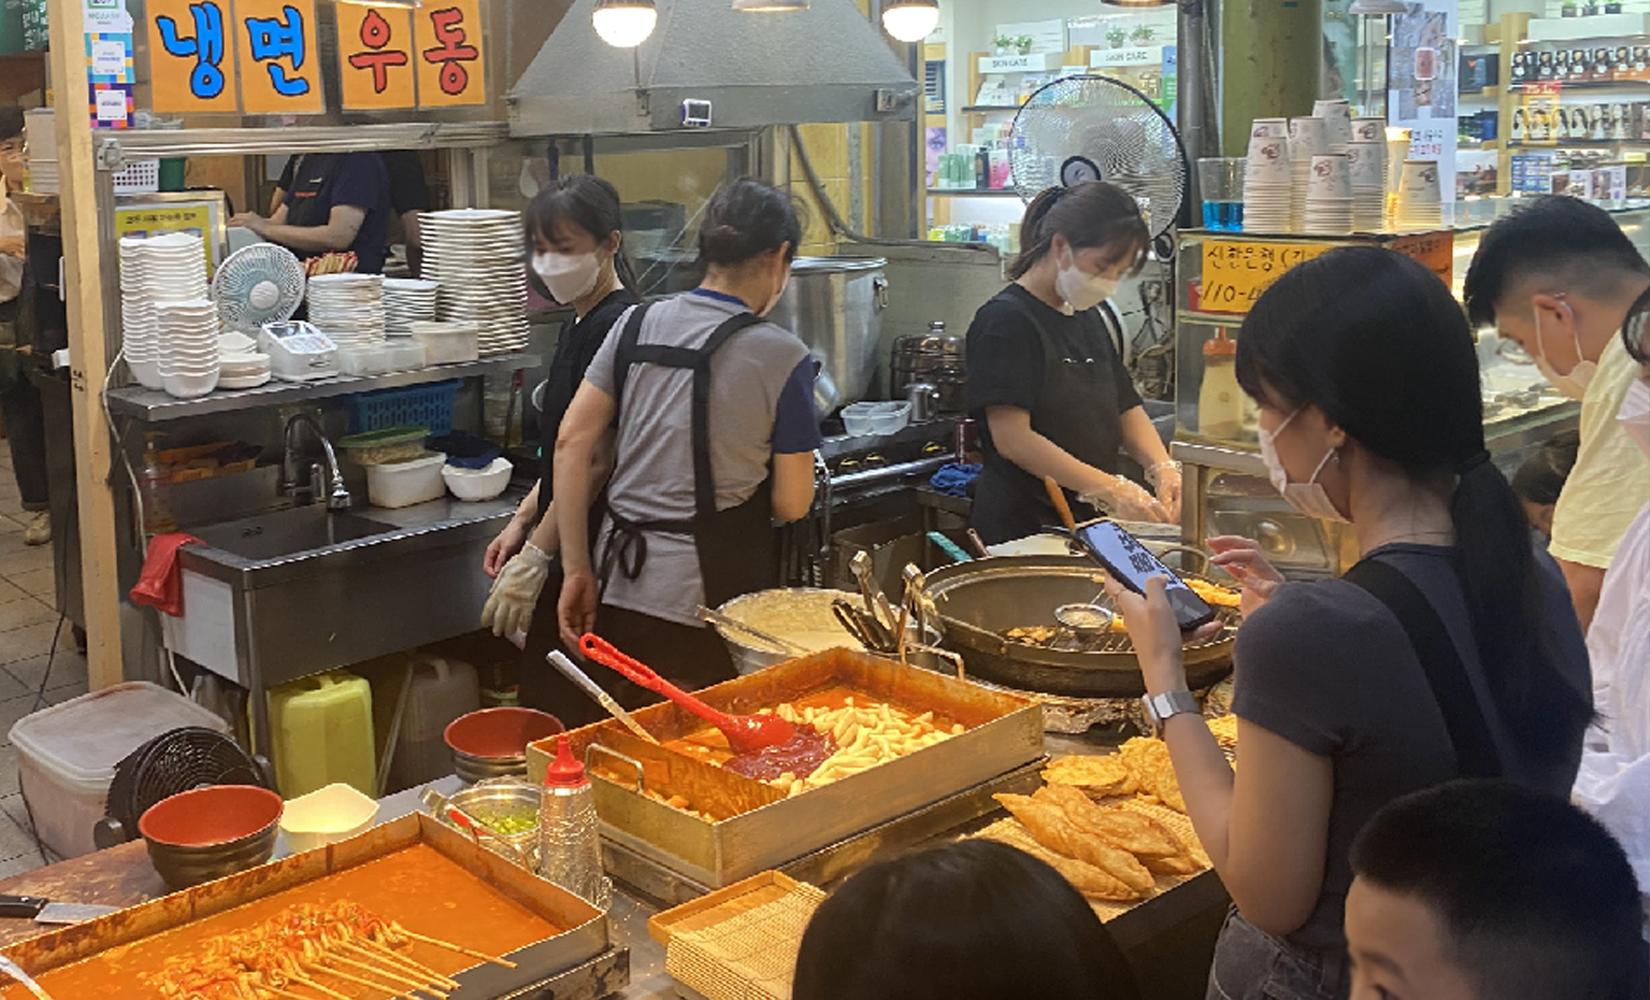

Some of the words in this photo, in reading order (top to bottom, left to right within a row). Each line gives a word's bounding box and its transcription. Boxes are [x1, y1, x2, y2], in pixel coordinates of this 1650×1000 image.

[155, 1, 309, 99] 냉면
[348, 7, 478, 95] 우동
[1207, 245, 1276, 272] 신한은행
